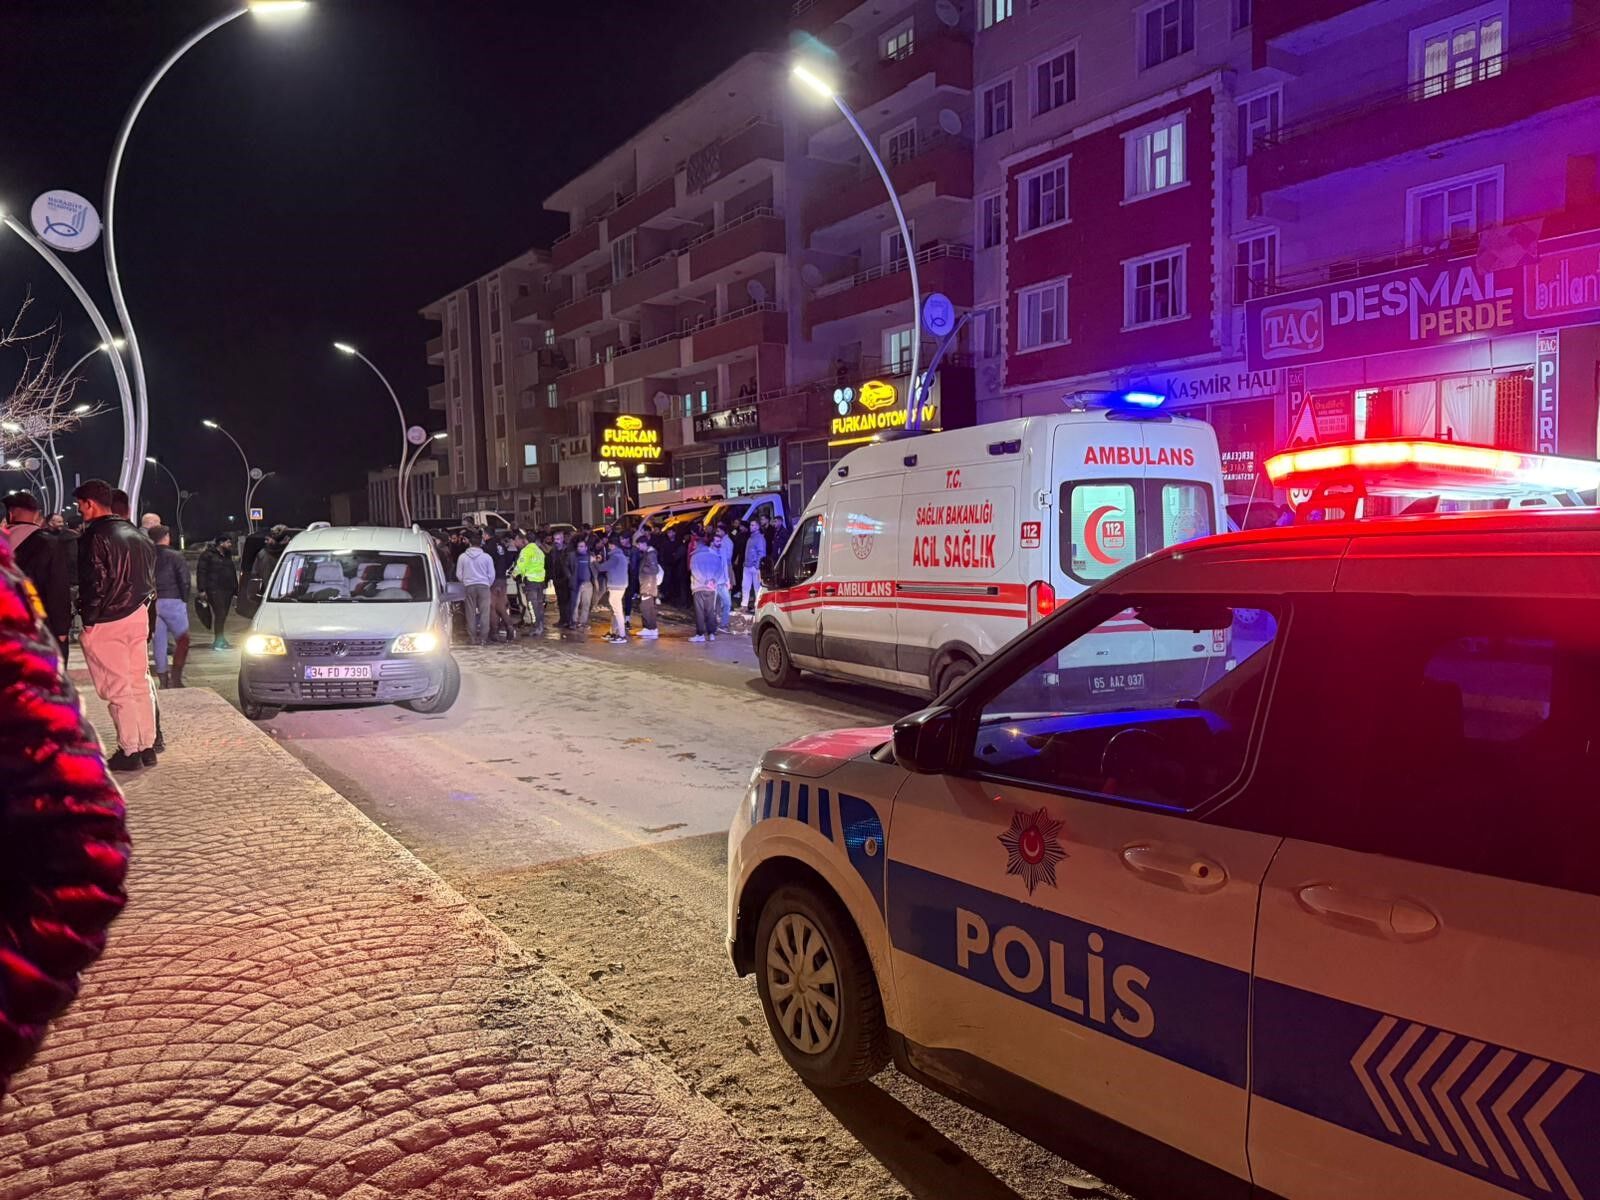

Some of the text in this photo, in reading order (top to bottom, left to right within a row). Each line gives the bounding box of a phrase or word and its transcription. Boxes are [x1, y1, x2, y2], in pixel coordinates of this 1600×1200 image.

[1330, 266, 1514, 340] DESMAL
[1420, 299, 1514, 338] PERDE
[1265, 310, 1319, 349] TAÇ
[1167, 369, 1276, 400] KAŞMİR HALI
[832, 413, 876, 434] FURKAN
[604, 428, 657, 442] FURKAN
[601, 444, 661, 458] OTOMOTİV
[1084, 446, 1195, 466] AMBULANS
[946, 469, 962, 489] T.C.
[916, 499, 993, 525] SAĞLIK BAKANLIĞI
[1023, 525, 1038, 537] 112
[1105, 522, 1121, 535] 112
[913, 529, 996, 568] ACİL SAĞLIK
[837, 582, 892, 596] AMBULANS
[312, 667, 368, 678] 34 FD 7390
[1094, 674, 1143, 689] 65 AAZ 037
[956, 907, 1155, 1038] POLİS
